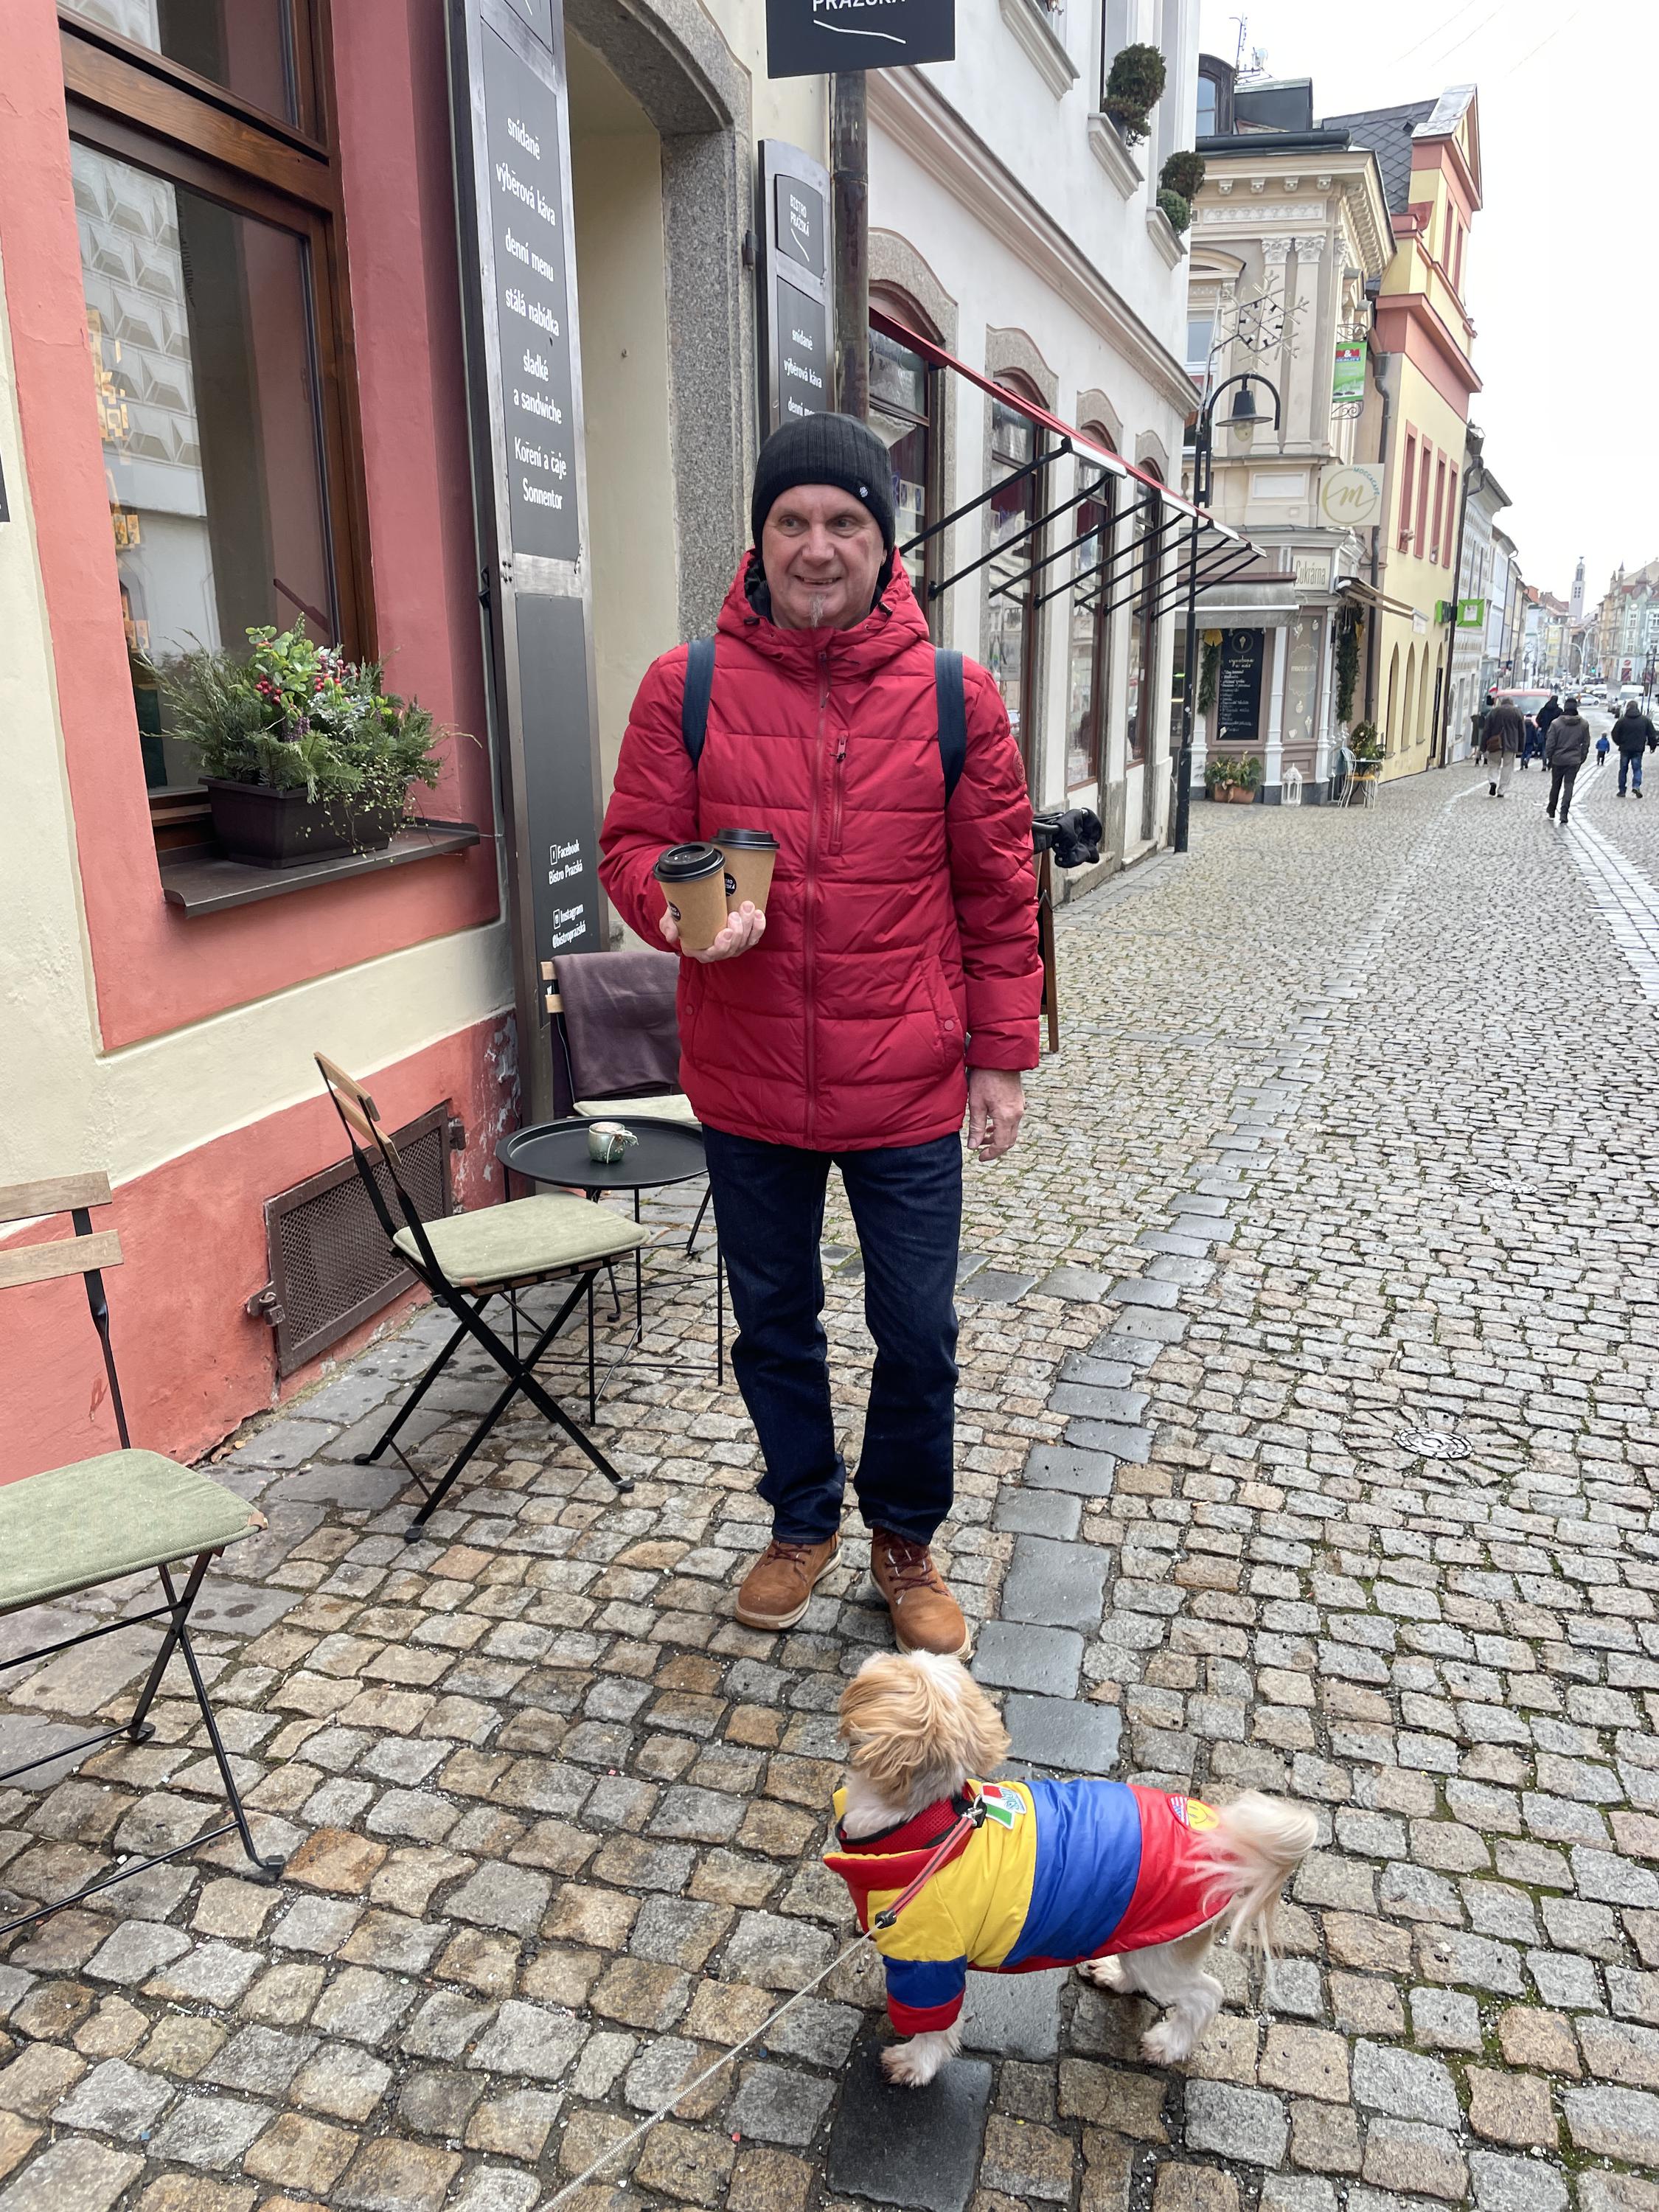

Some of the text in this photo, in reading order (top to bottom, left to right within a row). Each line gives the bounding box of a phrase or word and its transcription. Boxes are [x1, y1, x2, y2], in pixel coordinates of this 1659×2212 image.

[507, 117, 540, 160] snídaně
[495, 162, 555, 226] výběrová káva
[790, 194, 807, 218] BISTRO
[505, 228, 554, 282] denní menu
[505, 288, 559, 337] stálá nabídka
[523, 349, 549, 381] sladké
[810, 369, 822, 388] káva
[514, 389, 562, 424] a sandwiche
[787, 396, 803, 416] denní
[515, 437, 567, 479] Koření a čaje
[523, 478, 562, 509] Sonnentor
[557, 839, 580, 859] Facebook
[549, 869, 564, 885] Bistro
[560, 904, 584, 923] Instagram
